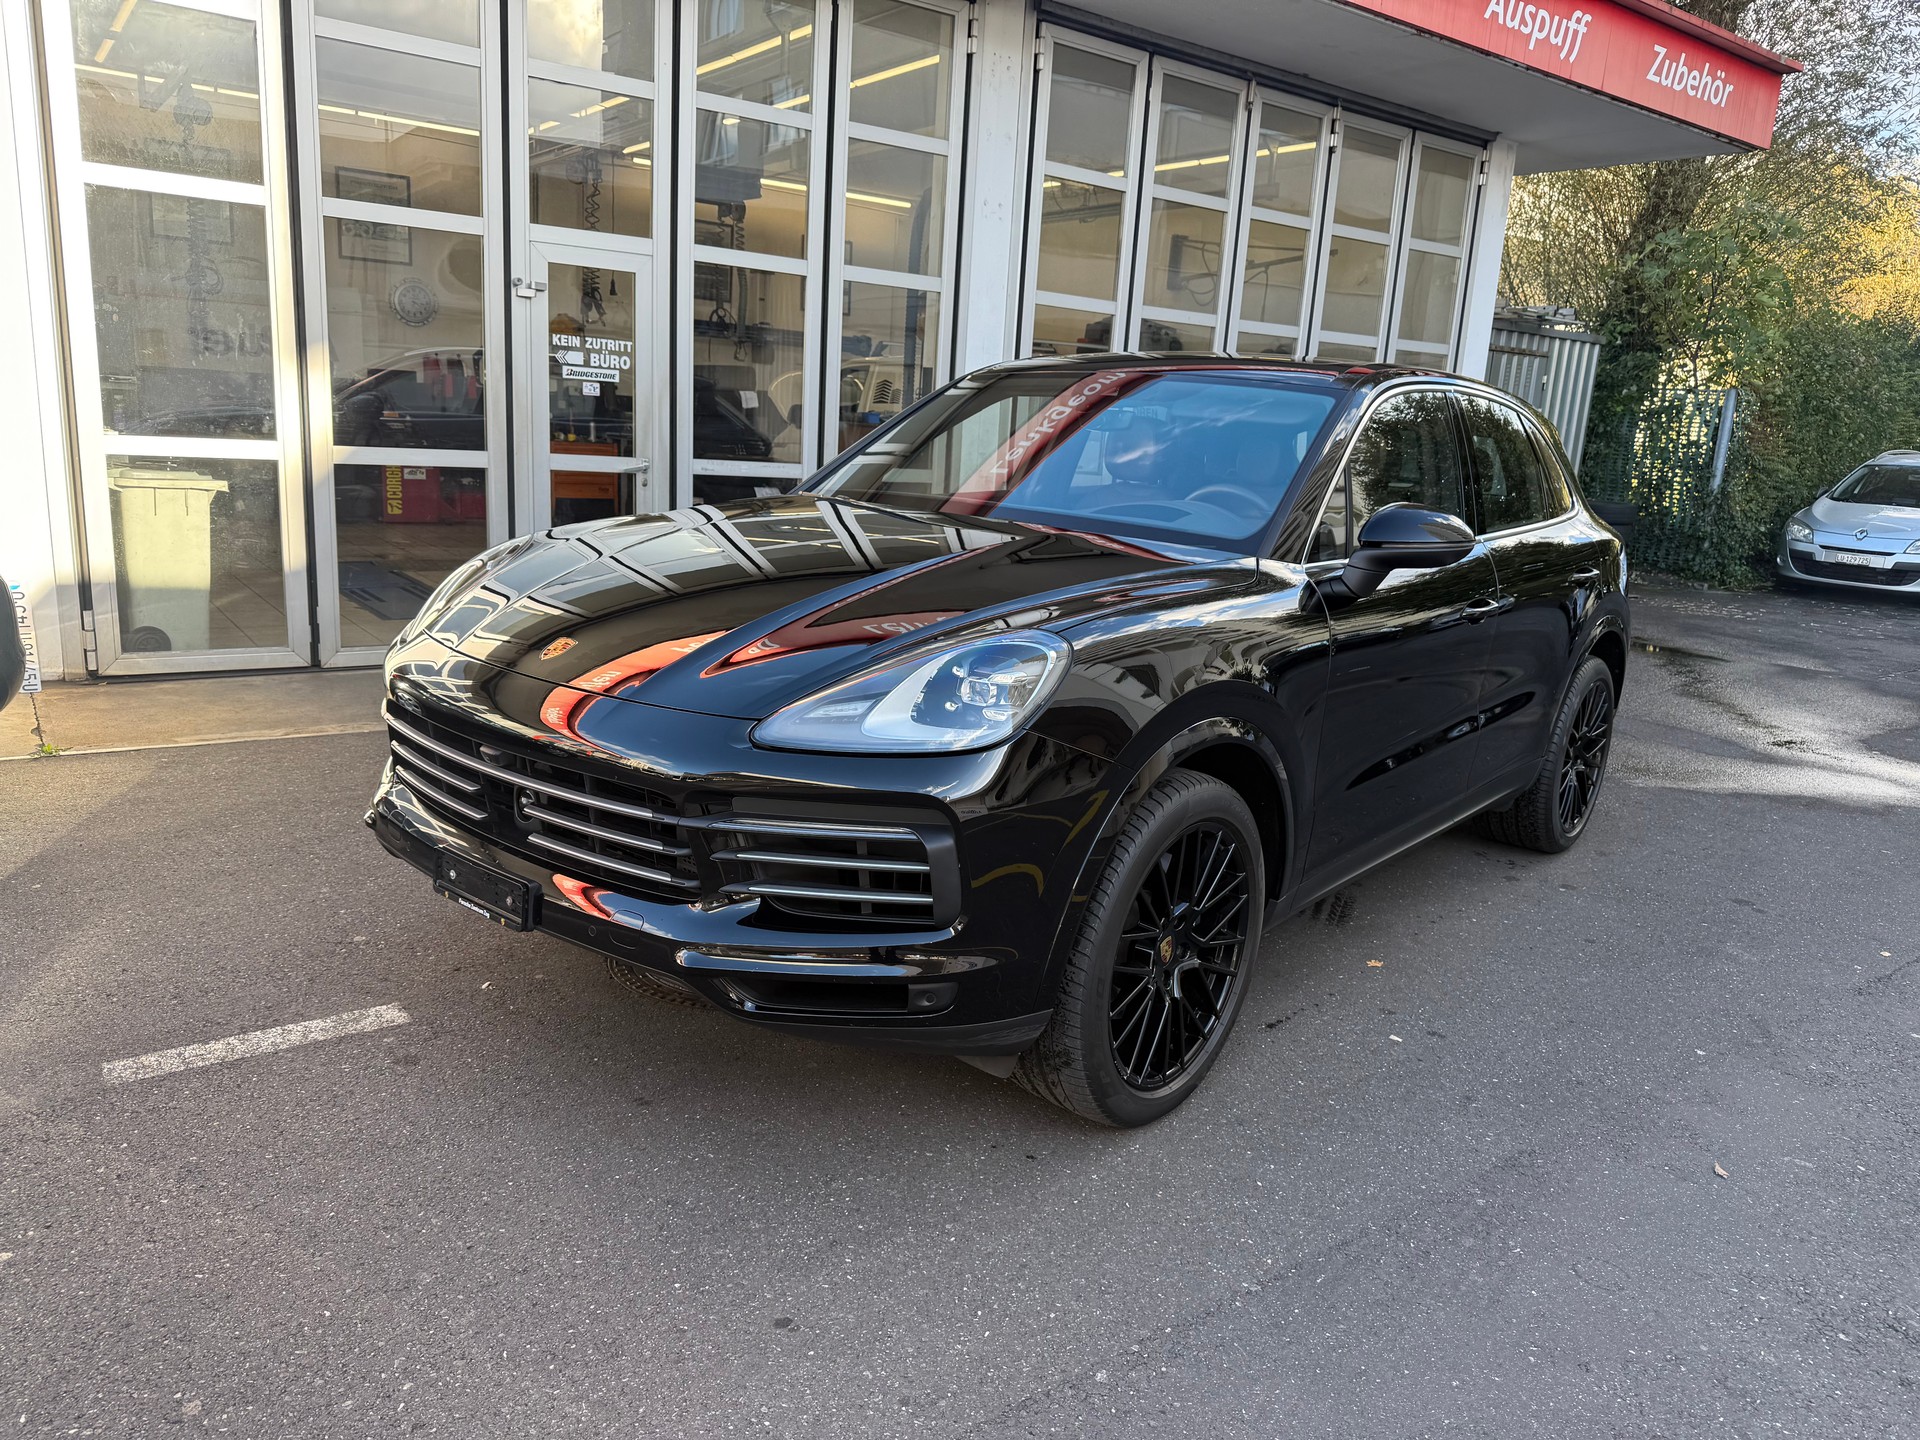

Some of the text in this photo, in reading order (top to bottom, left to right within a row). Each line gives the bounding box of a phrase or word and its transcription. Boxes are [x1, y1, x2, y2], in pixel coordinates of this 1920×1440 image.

[1484, 0, 1592, 63] Auspuff
[1646, 44, 1734, 108] Zubehör
[552, 333, 633, 352] KEIN ZUTRITT
[590, 350, 631, 370] BÜRO
[565, 368, 617, 380] BRIDGESTONE
